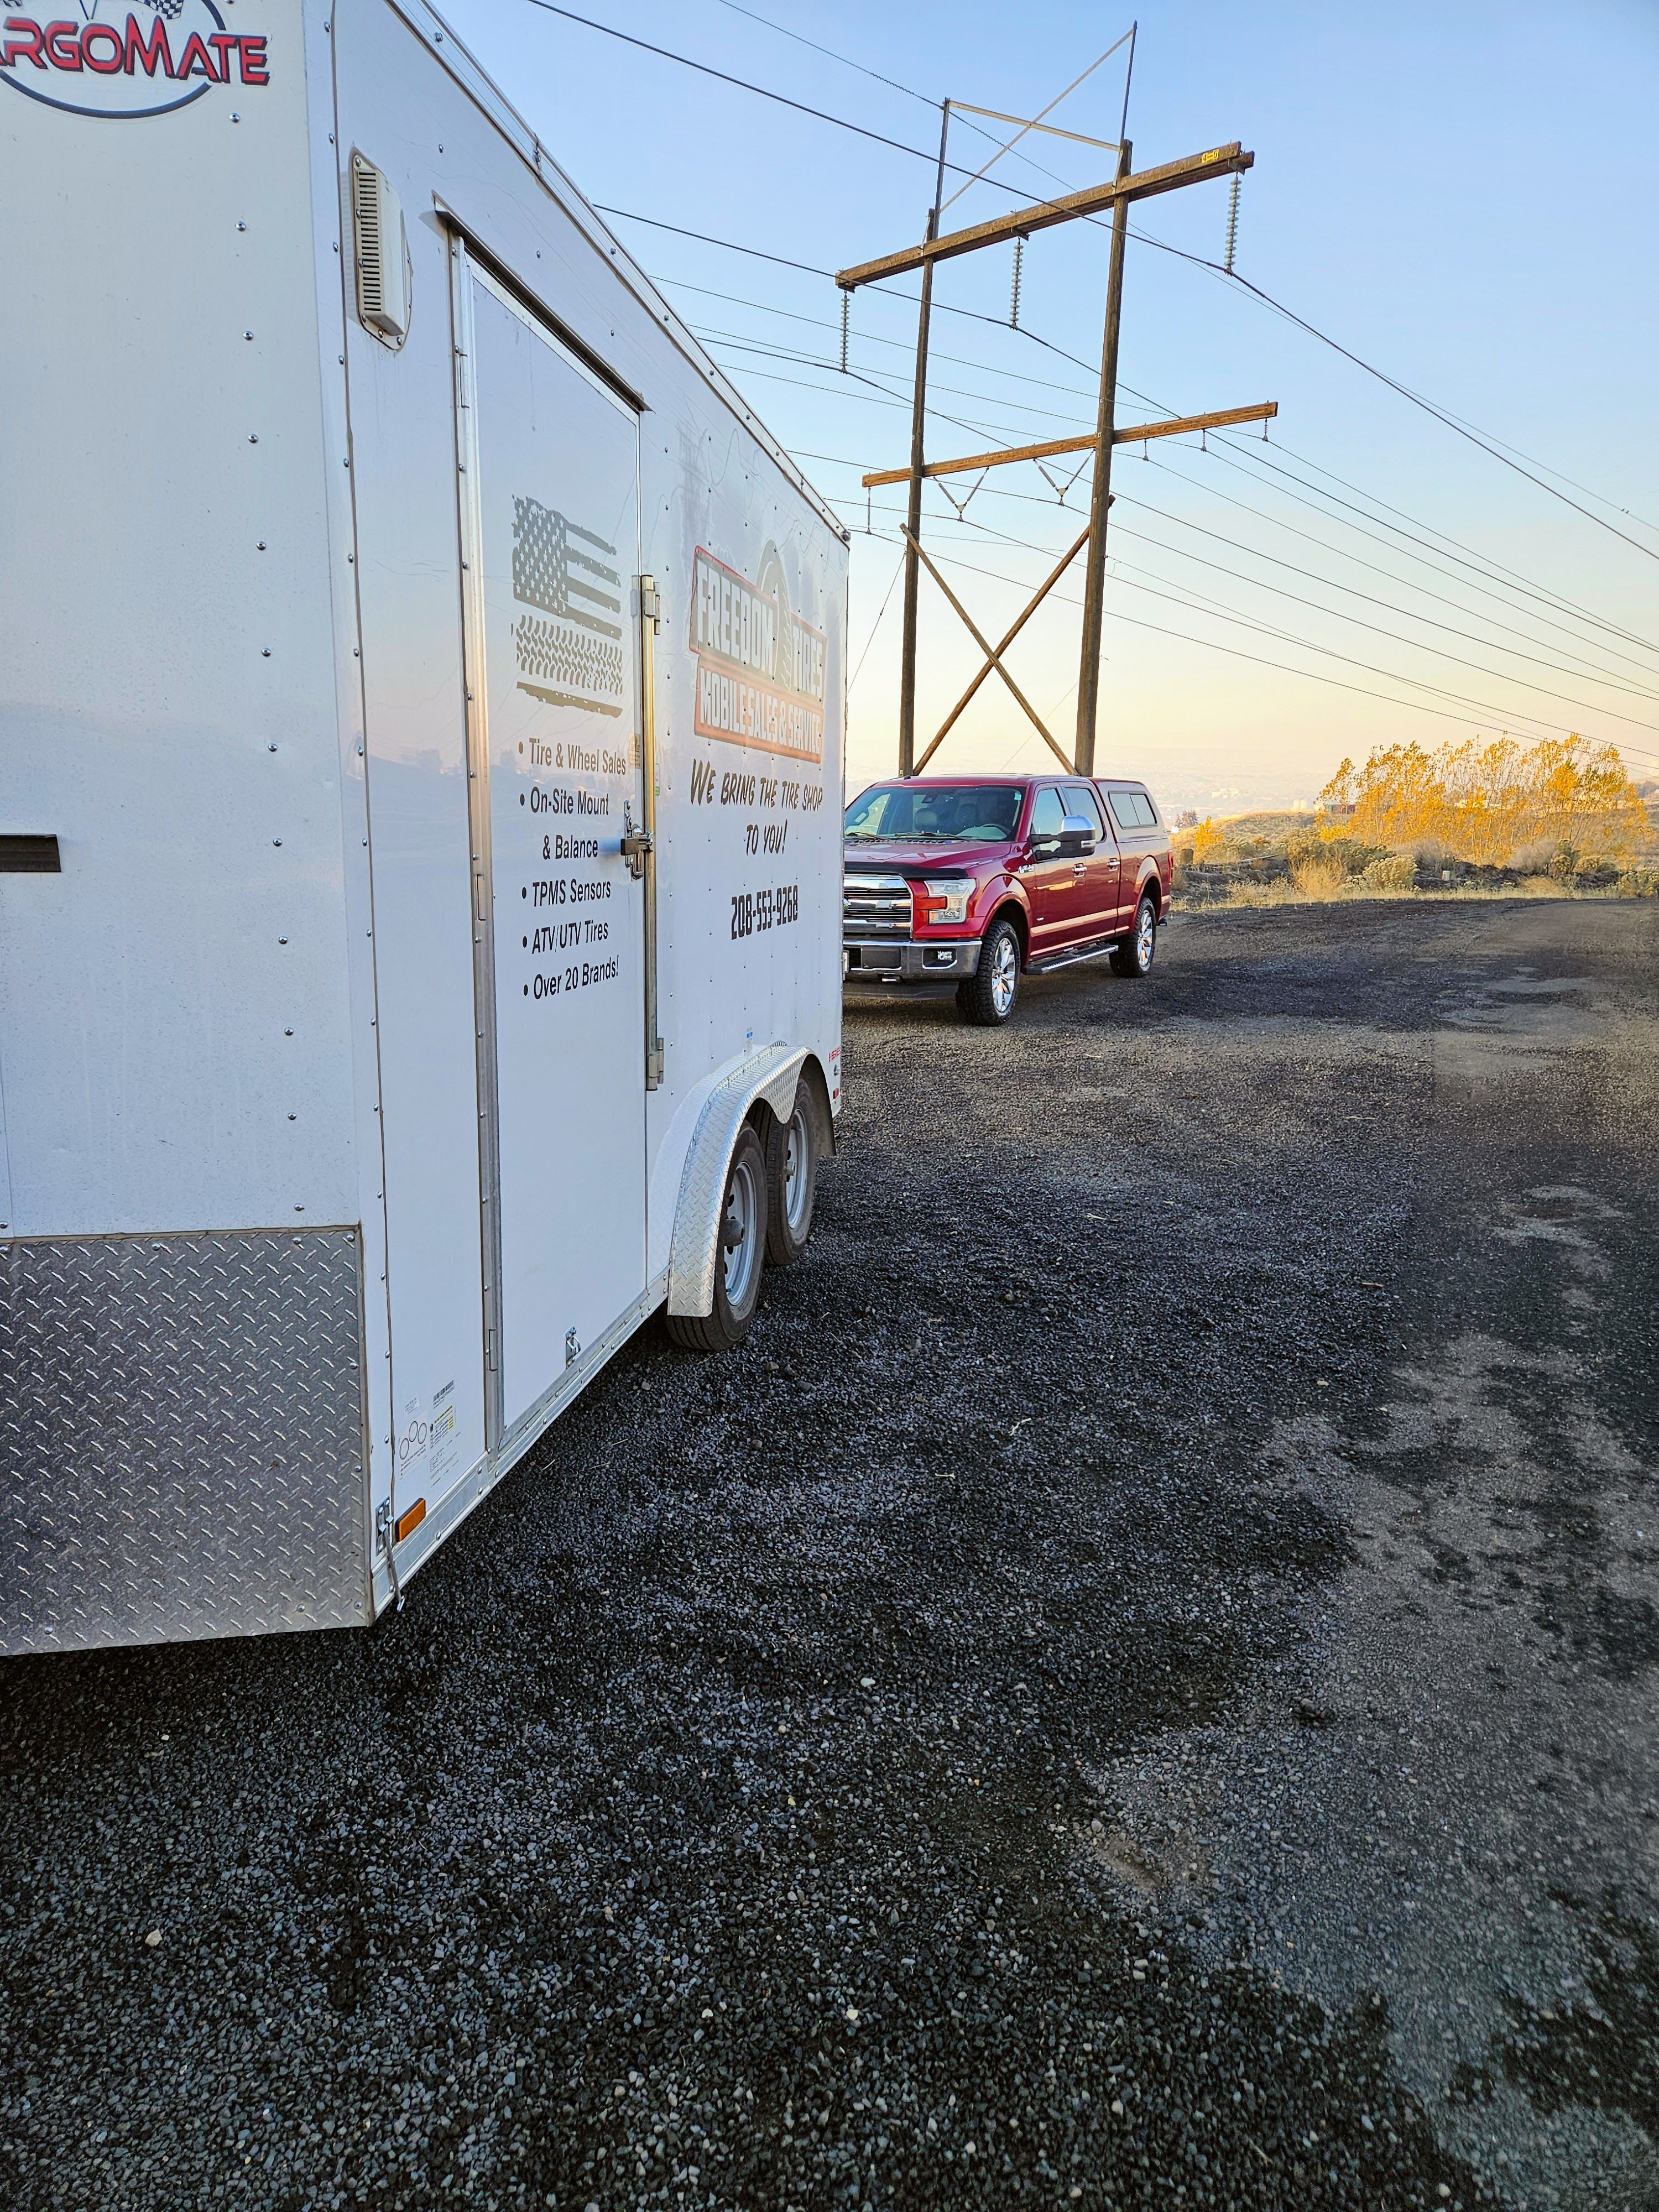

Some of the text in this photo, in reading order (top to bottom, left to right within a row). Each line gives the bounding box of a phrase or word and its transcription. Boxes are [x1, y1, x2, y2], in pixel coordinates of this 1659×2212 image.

[0, 13, 270, 85] RGOMATE
[697, 559, 822, 698] FREEDOM TIRES
[700, 667, 821, 754] MOBILE SALES & SERVICE
[529, 738, 626, 775] Tire & Wheel Sales
[530, 786, 609, 815] On-Site Mount
[691, 758, 823, 811] WE BRING THE TIRE SHOP
[542, 834, 598, 859] & Balance
[747, 818, 787, 855] TO YOU!
[533, 879, 611, 907] TPMS Sensors
[731, 885, 798, 940] 208-553-9268
[531, 920, 608, 954] ATV/UTV Tires
[534, 955, 619, 1000] Over 20 Brands!
